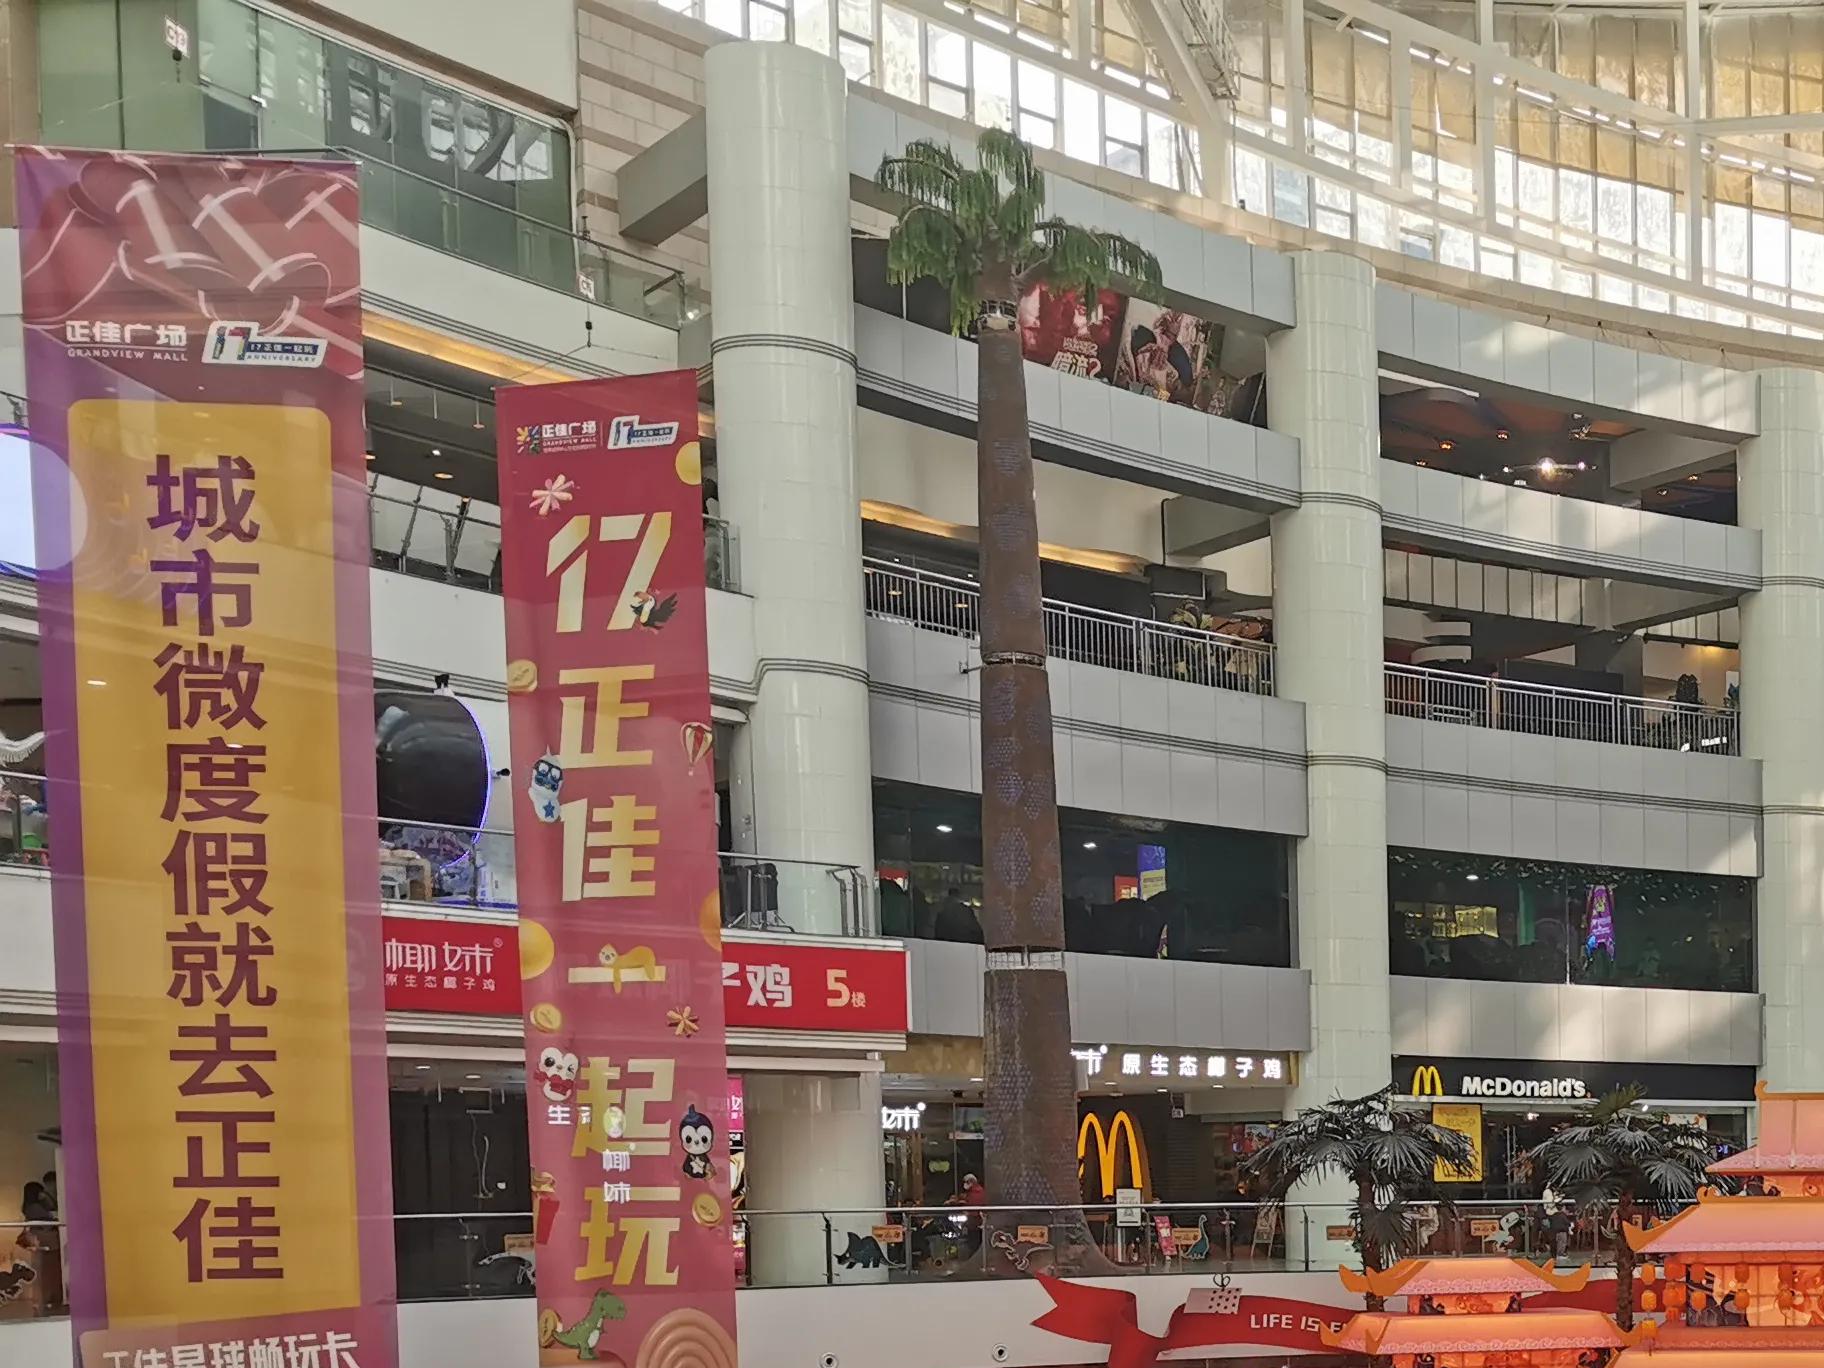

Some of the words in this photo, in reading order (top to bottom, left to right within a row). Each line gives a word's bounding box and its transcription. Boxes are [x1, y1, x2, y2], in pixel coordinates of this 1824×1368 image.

[65, 320, 188, 346] 正佳广场
[67, 347, 145, 360] GRANDVIEW
[153, 352, 188, 362] MALL
[542, 421, 597, 438] 正佳广场
[145, 454, 286, 1284] 城市微度假就去正佳
[1122, 1053, 1283, 1079] 原生态椰子鸡
[1461, 1075, 1587, 1098] McDonald's
[1250, 1313, 1293, 1329] LIFE
[1301, 1316, 1320, 1332] IS
